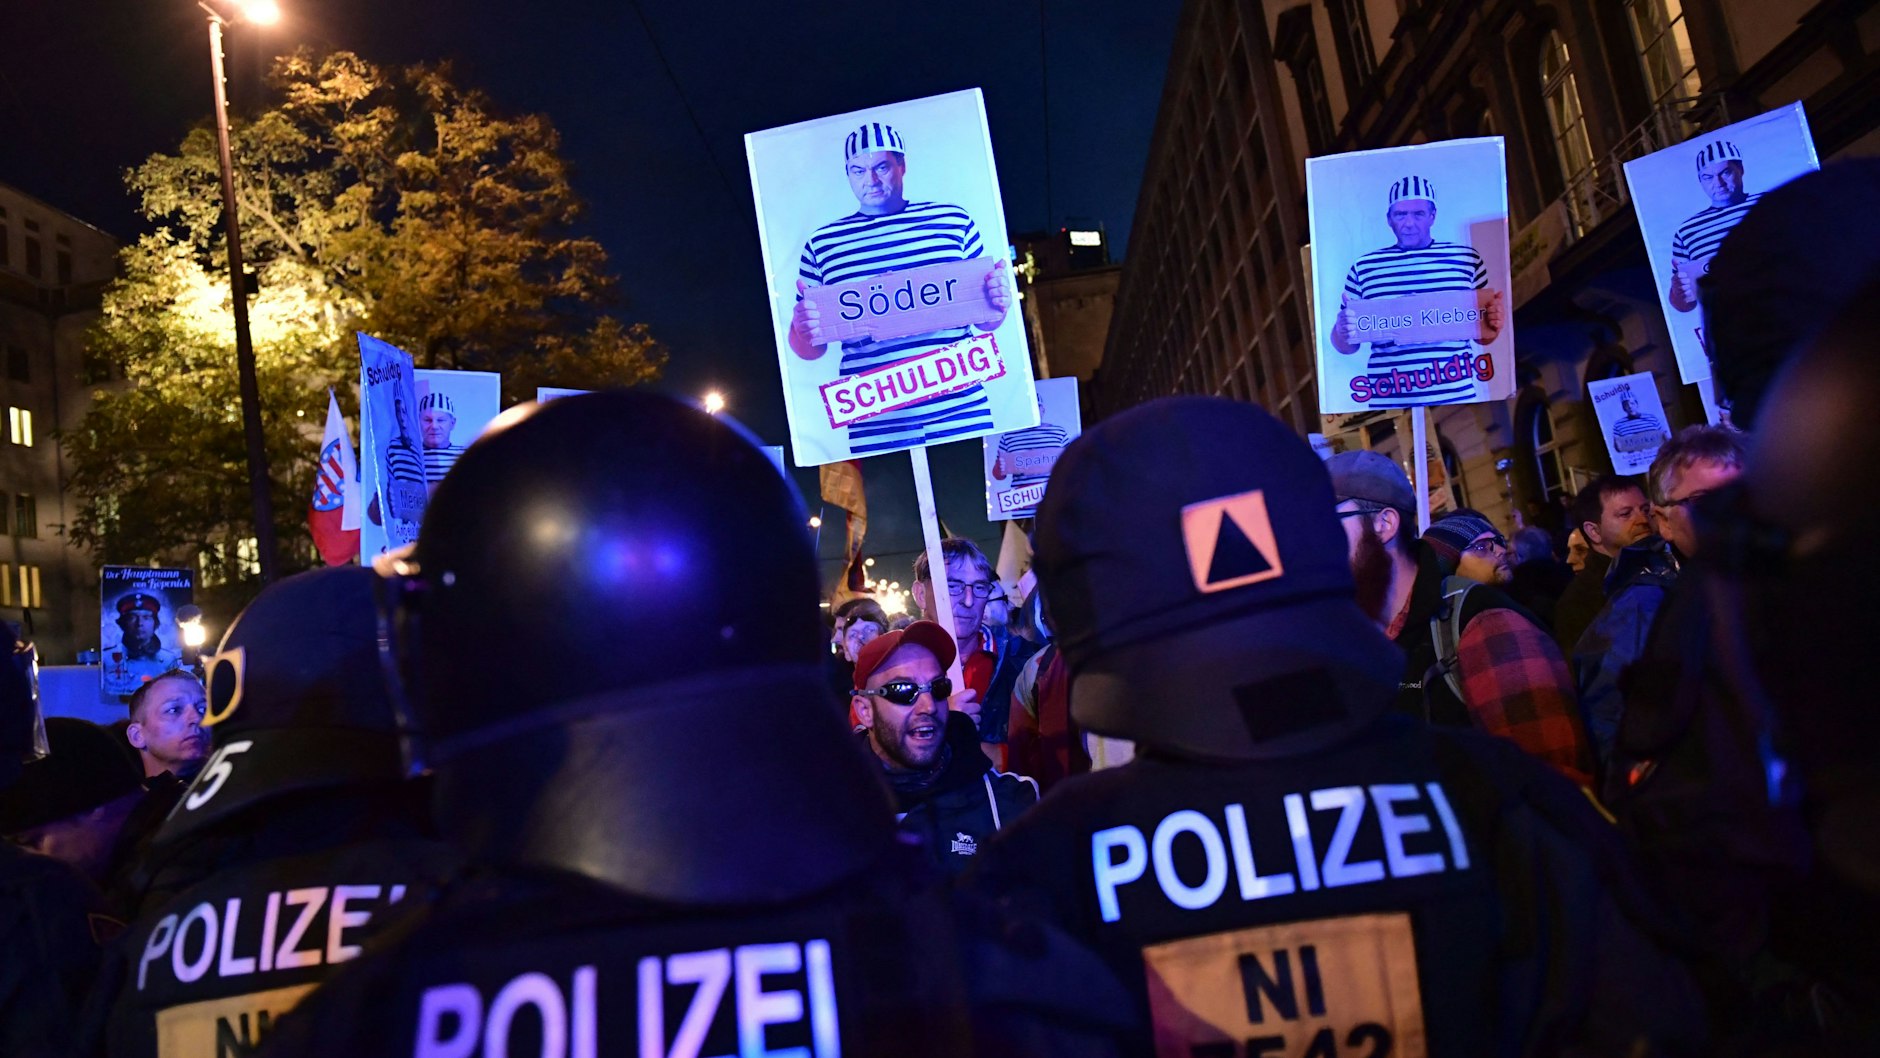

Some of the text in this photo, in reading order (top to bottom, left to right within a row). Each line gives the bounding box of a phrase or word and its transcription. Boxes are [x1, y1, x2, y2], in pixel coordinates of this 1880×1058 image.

[838, 279, 958, 321] Söder
[1356, 306, 1488, 332] Claus Kleber
[834, 346, 991, 415] SCHULDIG
[1350, 351, 1495, 403] Schuldig
[1594, 383, 1631, 404] Schuldig
[105, 568, 180, 580] Der Hauptmann
[1091, 781, 1471, 923] POLIZEI
[136, 884, 407, 991] POLIZE
[1238, 944, 1327, 1025] NI
